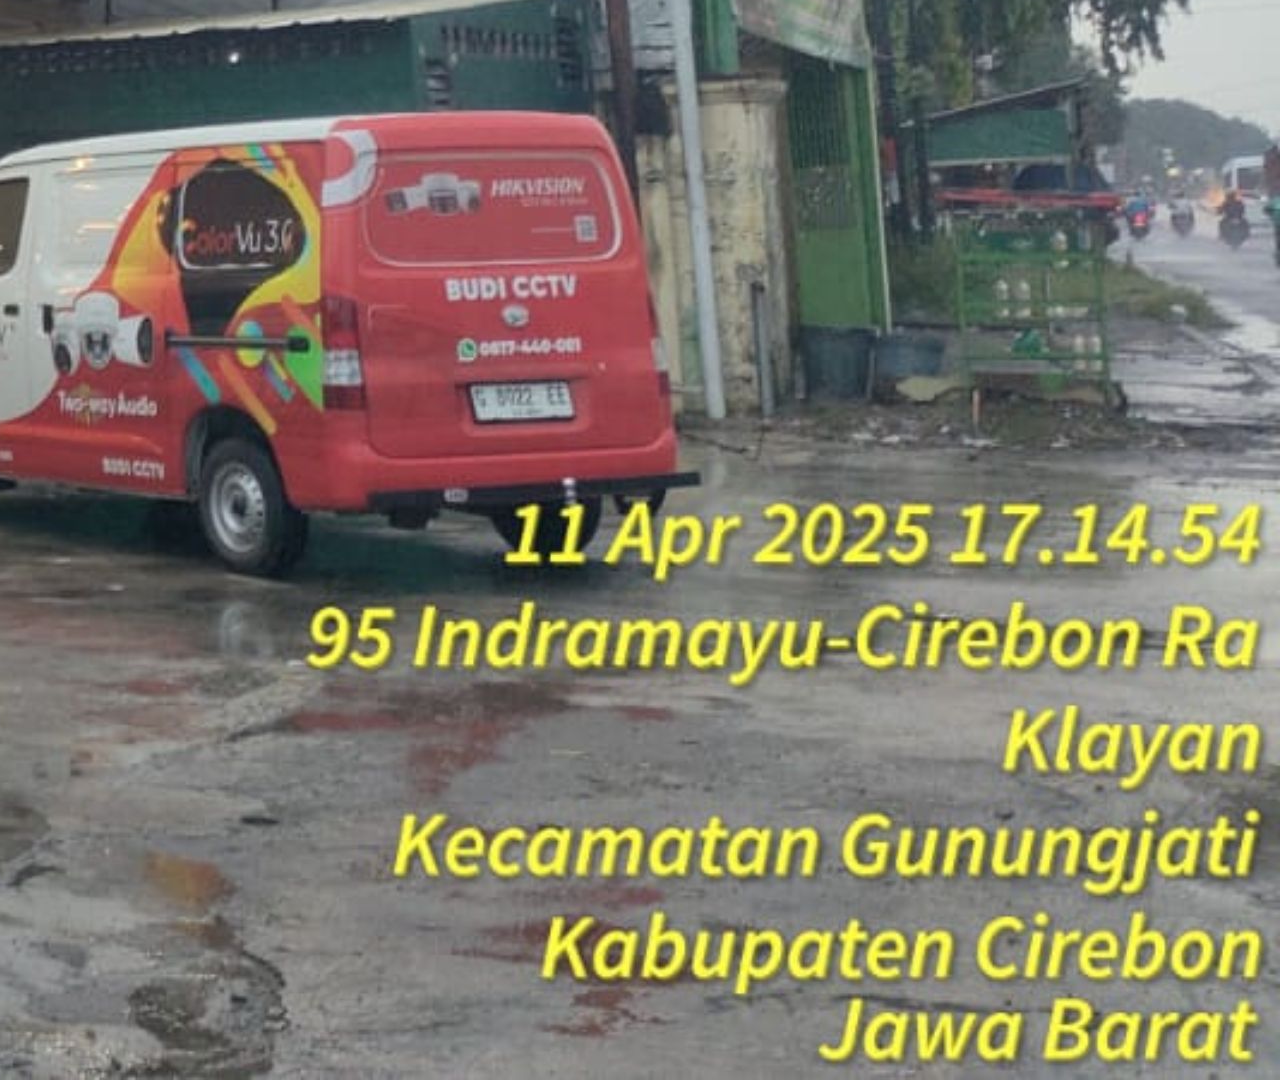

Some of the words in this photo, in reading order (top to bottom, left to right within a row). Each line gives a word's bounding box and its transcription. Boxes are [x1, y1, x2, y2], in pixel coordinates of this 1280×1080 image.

[491, 177, 587, 198] HIKVISION
[445, 276, 507, 301] BUDI
[512, 274, 577, 299] CCTV
